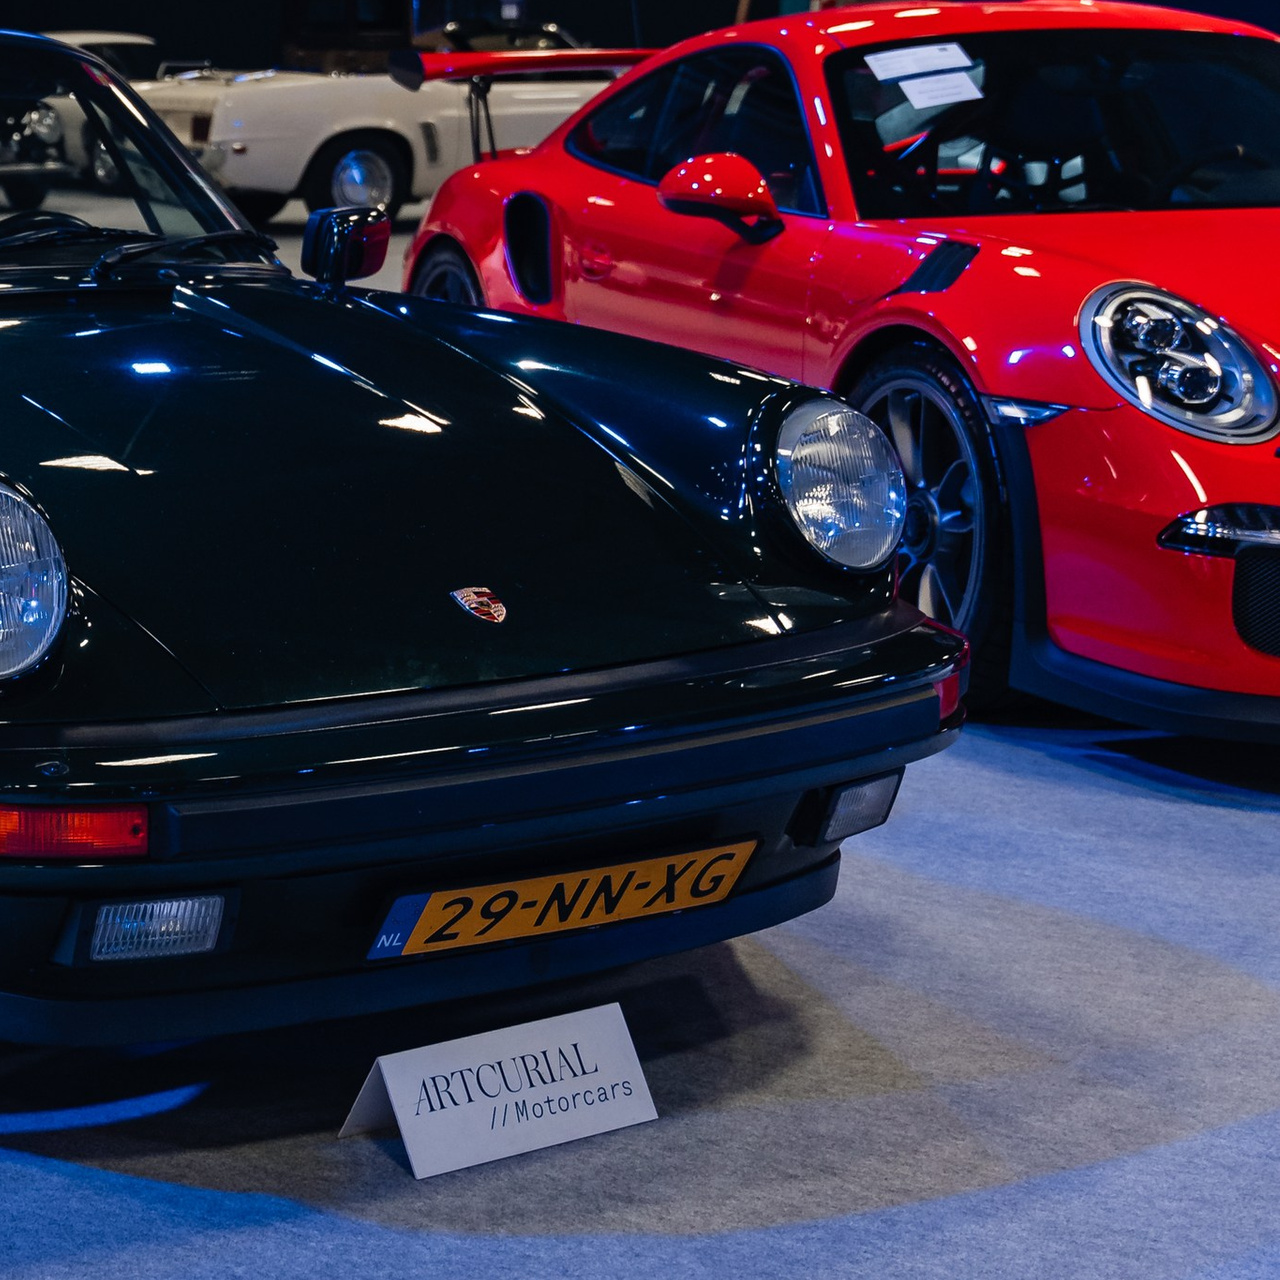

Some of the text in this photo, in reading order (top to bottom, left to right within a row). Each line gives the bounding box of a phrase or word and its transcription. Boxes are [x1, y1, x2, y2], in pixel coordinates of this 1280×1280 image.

[423, 852, 737, 945] 29-NN-XG
[377, 932, 402, 948] NL
[414, 1042, 599, 1116] ARTCURIAL
